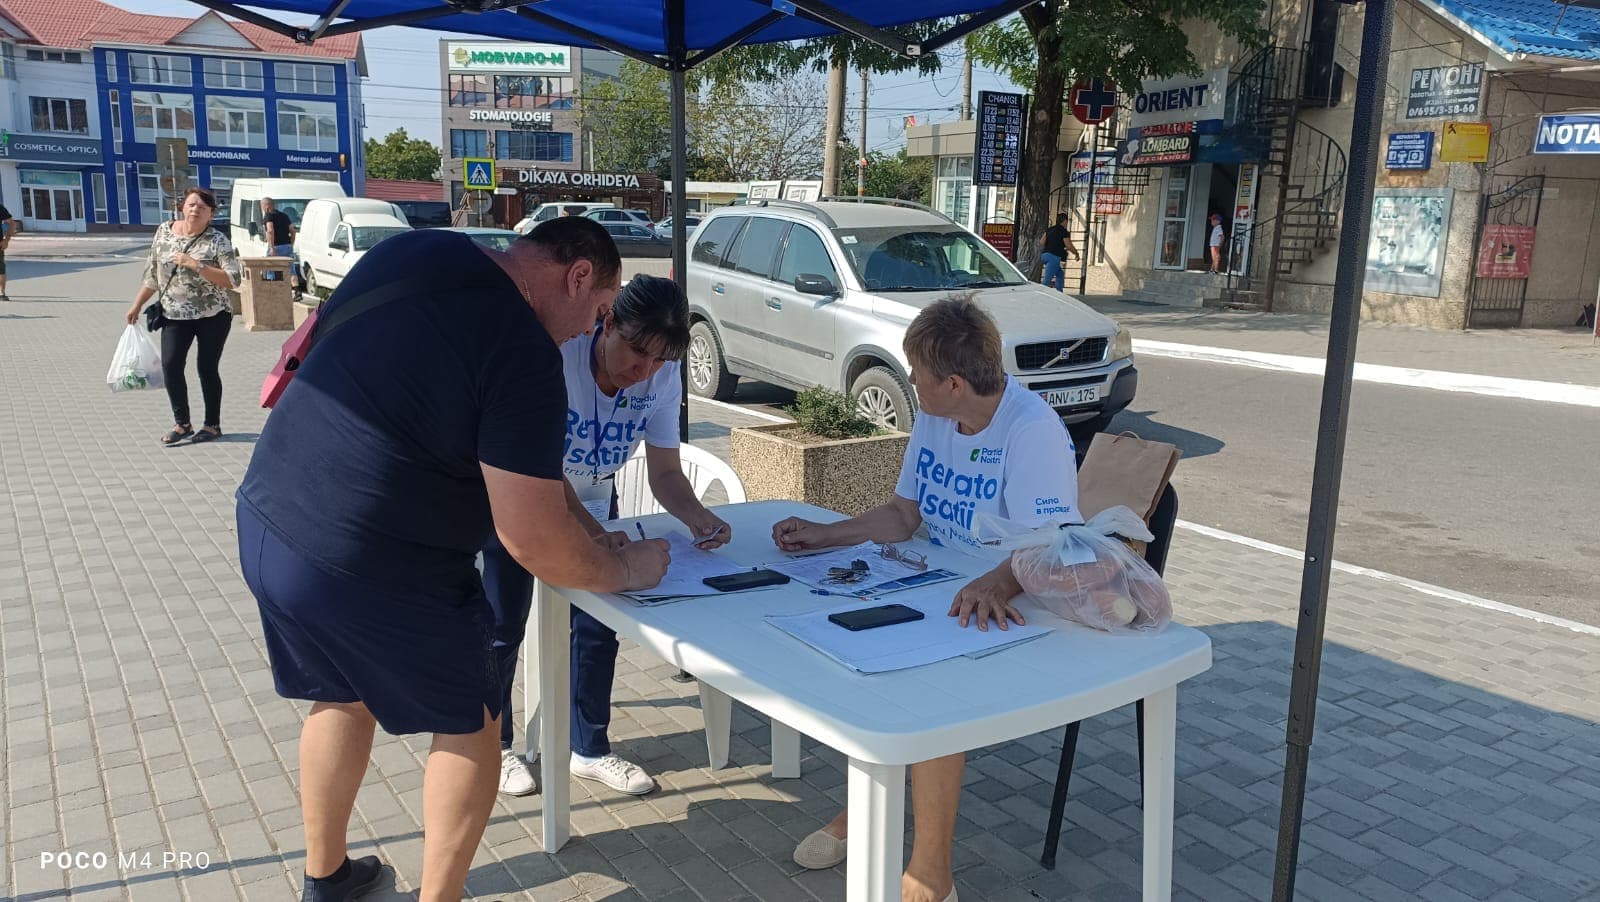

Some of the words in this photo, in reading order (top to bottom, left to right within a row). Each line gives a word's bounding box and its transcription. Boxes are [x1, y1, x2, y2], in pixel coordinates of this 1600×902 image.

[471, 51, 565, 66] MOBVARO-M
[1135, 84, 1209, 114] ORIENT
[469, 110, 552, 122] STOMATOLOGIE
[1539, 120, 1600, 145] NOTA
[14, 143, 62, 152] COSMETICA
[67, 146, 98, 154] OPTICA
[1141, 137, 1190, 153] LOMBARD
[188, 151, 250, 161] LDINDCONBANK
[519, 170, 568, 185] DIKAYA
[571, 172, 640, 188] ORHIDEYA
[630, 393, 657, 404] Pardul
[1049, 391, 1070, 406] ANV
[1077, 388, 1095, 402] 175
[982, 447, 1003, 456] Partid
